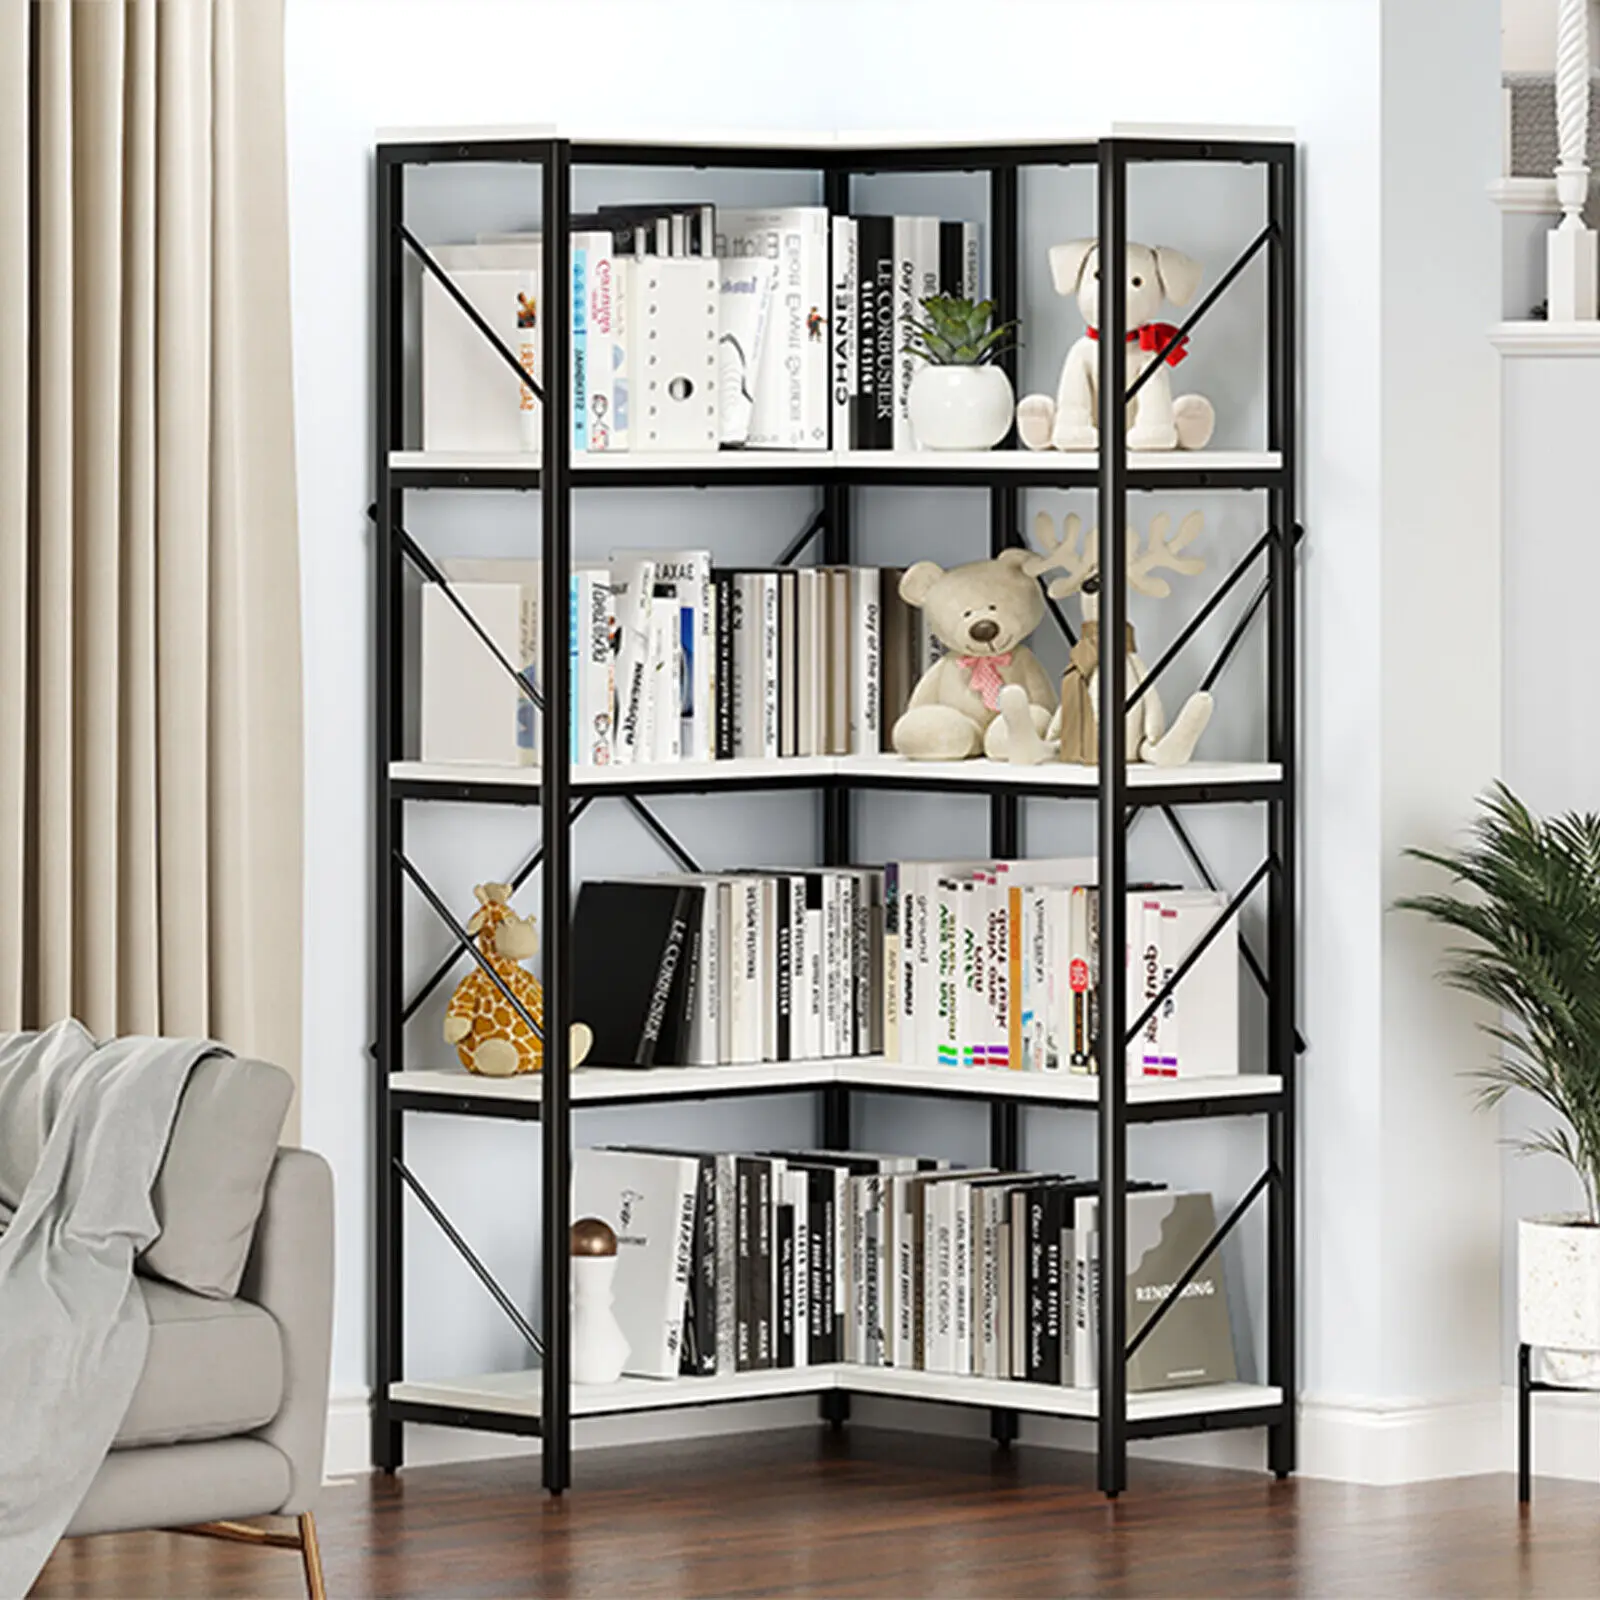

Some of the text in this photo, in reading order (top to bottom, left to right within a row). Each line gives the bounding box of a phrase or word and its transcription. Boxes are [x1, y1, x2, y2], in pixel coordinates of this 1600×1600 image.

[835, 276, 848, 405] CHANEL
[876, 259, 893, 419] LE CORBUSIER
[865, 604, 879, 632] Day
[865, 654, 877, 678] the
[865, 682, 878, 731] design
[644, 919, 687, 1042] LE CORBUSIER
